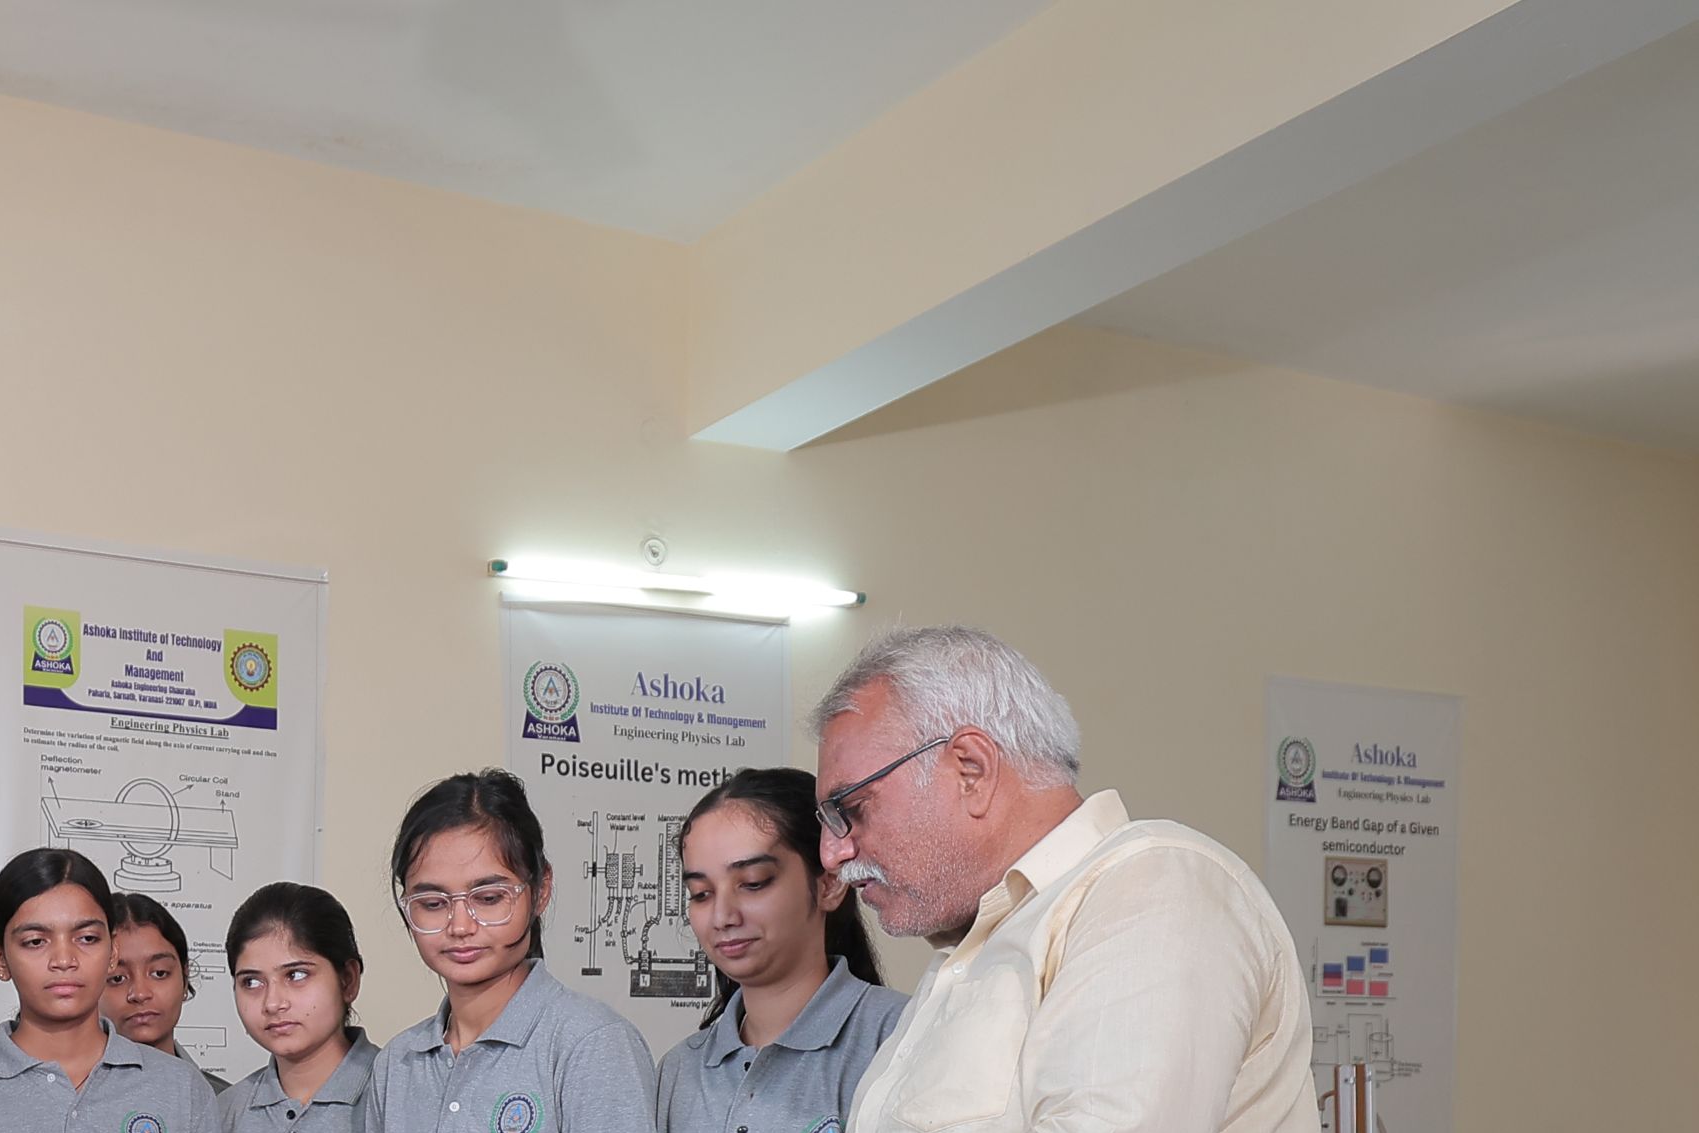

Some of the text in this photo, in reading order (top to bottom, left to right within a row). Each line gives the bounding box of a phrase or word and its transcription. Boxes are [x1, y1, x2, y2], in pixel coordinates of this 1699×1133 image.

[82, 623, 222, 652] Ashoka Institute of Technology
[145, 648, 163, 662] And
[35, 659, 71, 671] ASHOKA
[124, 664, 184, 682] Management
[630, 671, 726, 704] Ashoka
[589, 701, 767, 729] Institute Of Technology & Management
[110, 716, 230, 738] Engineering Physics Lab
[527, 722, 576, 736] ASHOKA
[612, 724, 745, 749] Engineering Physics Lab
[40, 754, 83, 764] Deflection
[1351, 742, 1417, 768] Ashoka
[40, 764, 102, 774] magnetometer
[541, 753, 671, 783] Poiseuille's
[178, 773, 228, 785] Circular Coil
[214, 789, 240, 798] Stand
[1288, 812, 1439, 836] Energy Band Gap of a Given
[1322, 840, 1405, 856] semiconductor
